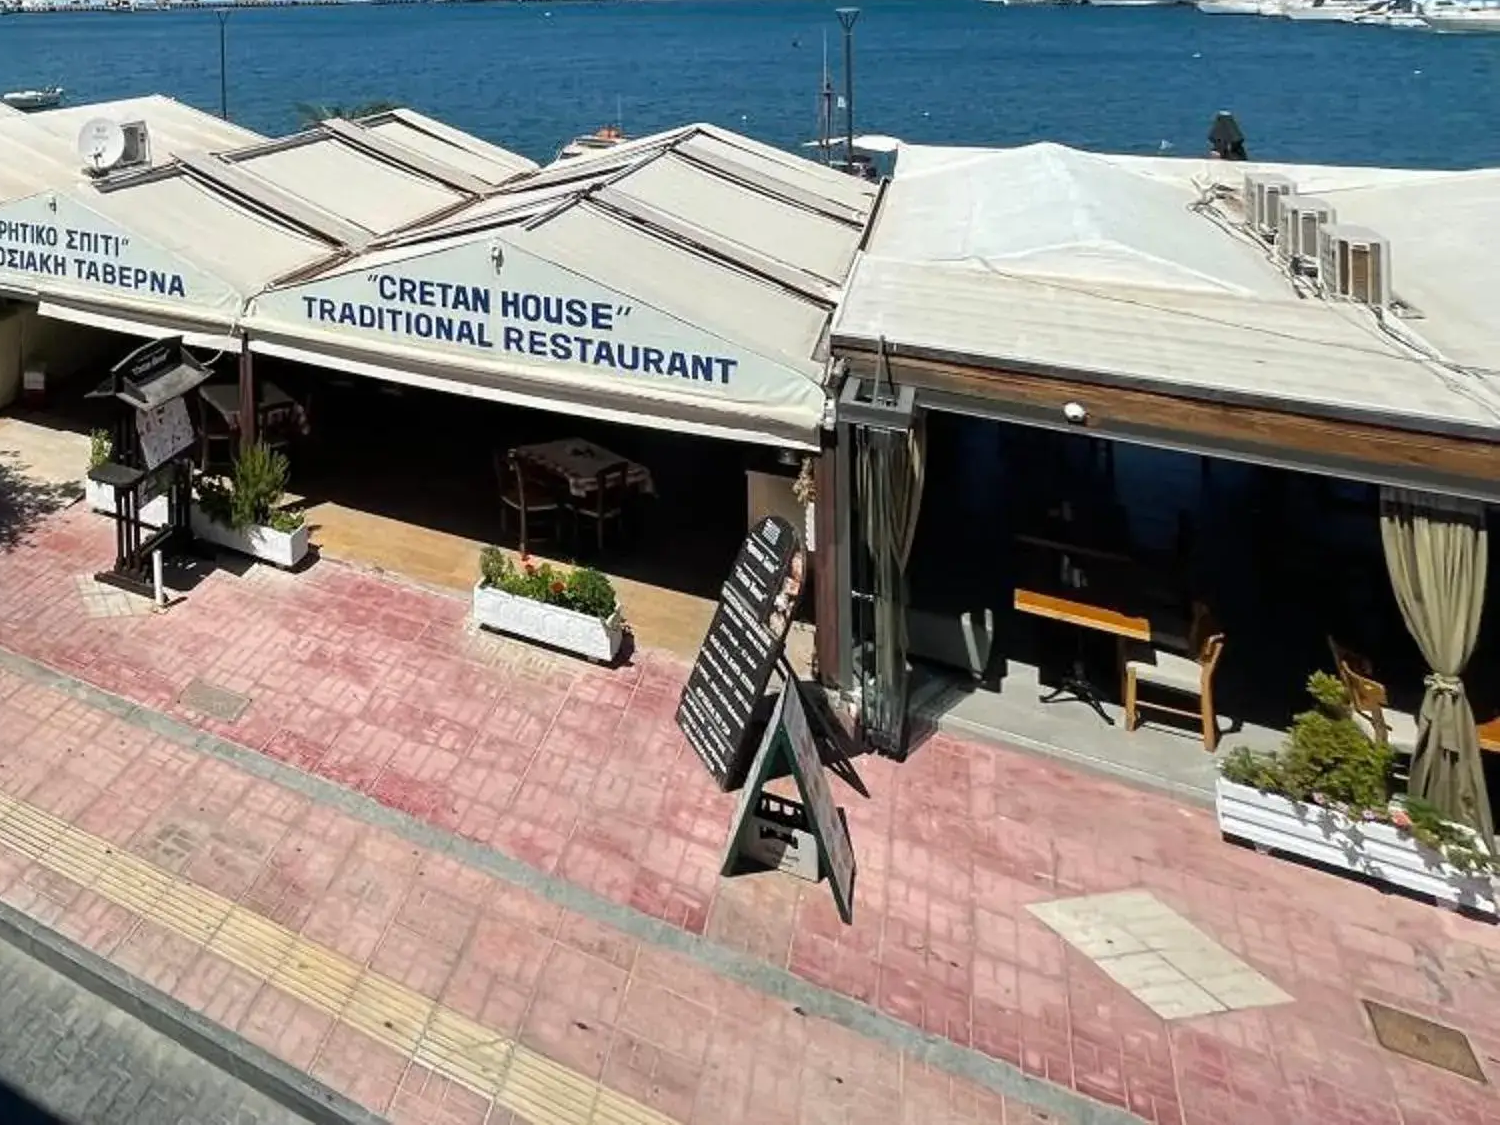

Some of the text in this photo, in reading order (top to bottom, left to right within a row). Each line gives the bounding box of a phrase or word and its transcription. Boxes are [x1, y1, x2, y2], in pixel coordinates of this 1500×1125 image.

[74, 258, 186, 297] ΤΑΒΕΡΝΑ
[302, 296, 738, 384] TRADITIONAL RESTAURANT
